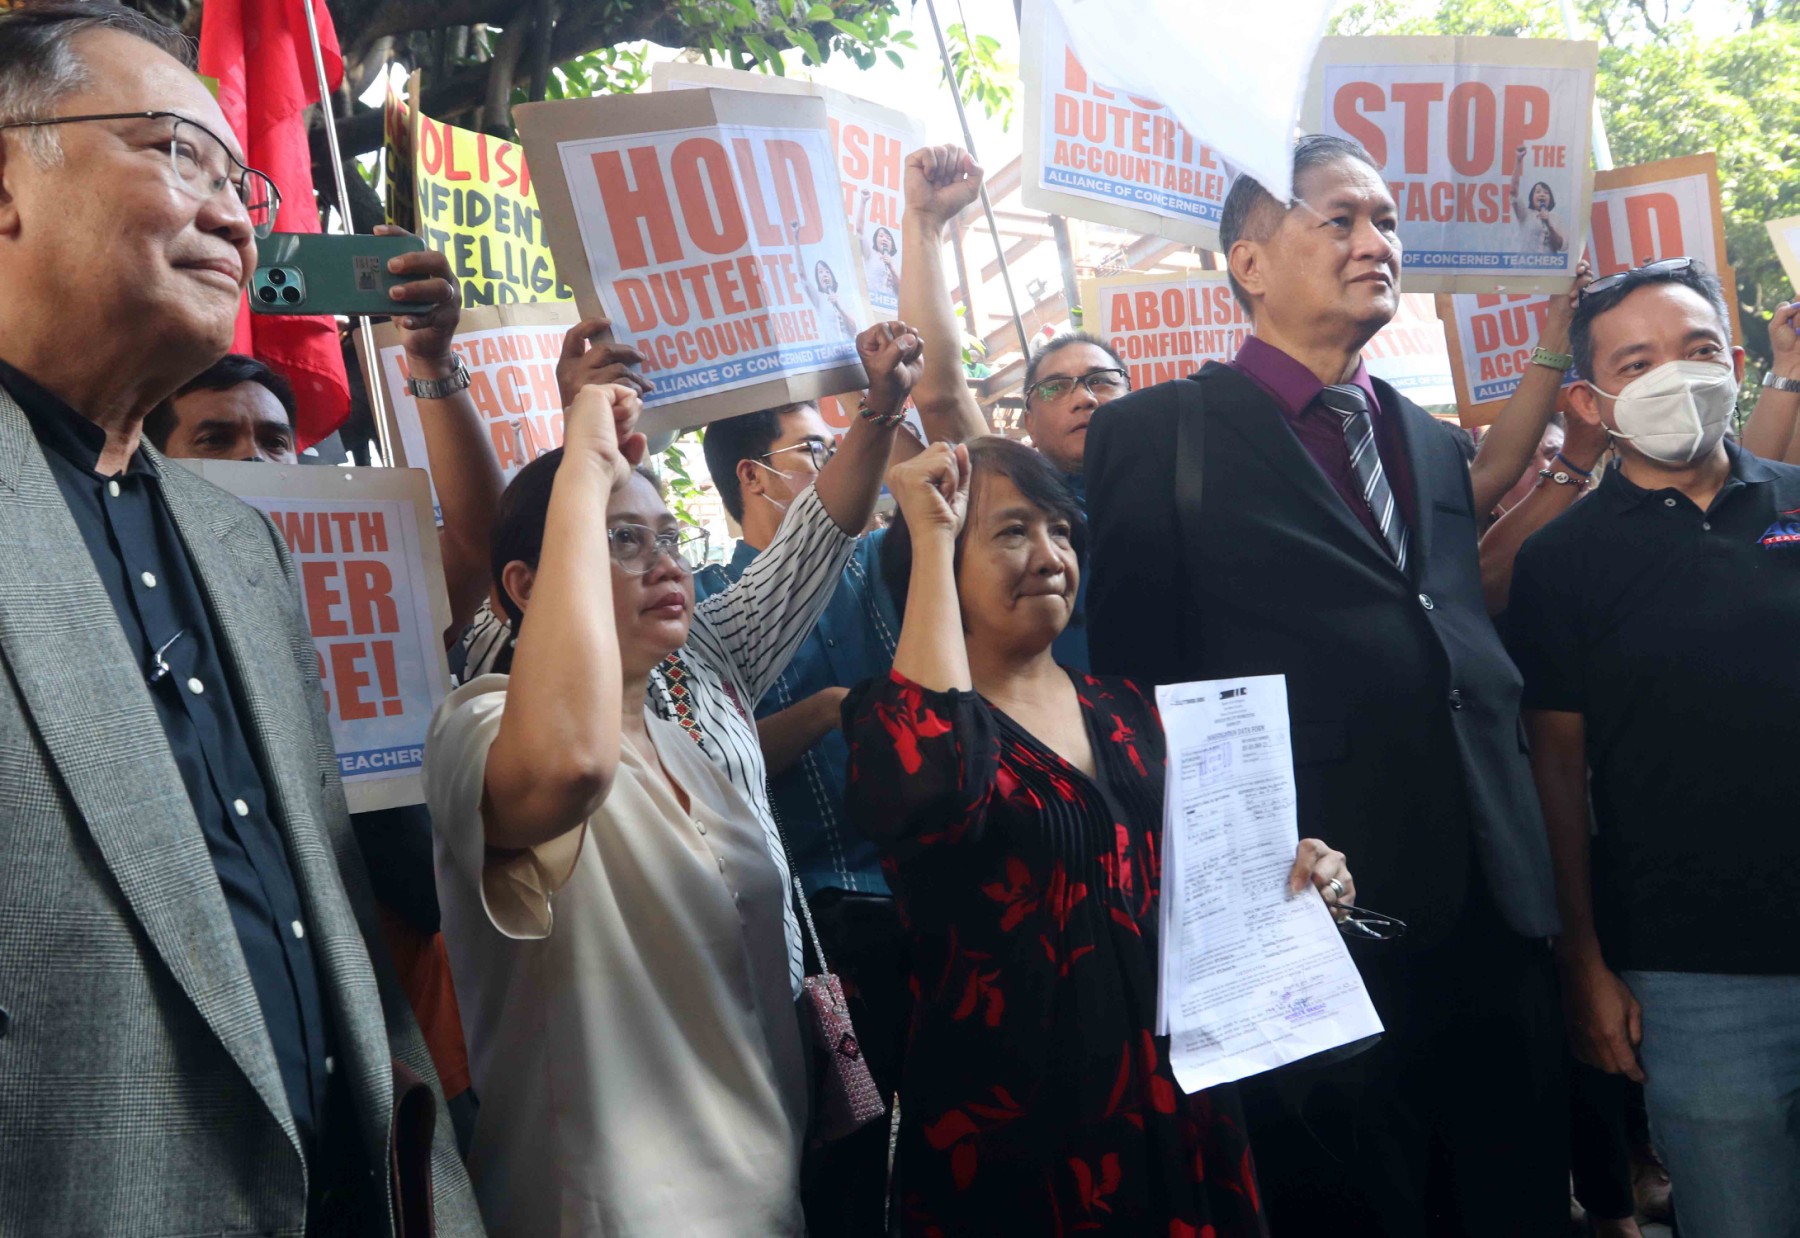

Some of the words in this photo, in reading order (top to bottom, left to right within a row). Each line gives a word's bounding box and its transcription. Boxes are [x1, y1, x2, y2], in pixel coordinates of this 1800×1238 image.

[417, 115, 530, 197] OLIS
[1333, 82, 1550, 177] STOP
[1531, 145, 1566, 168] THE
[1048, 170, 1111, 194] ALLIANCE
[1114, 184, 1131, 197] OF
[1135, 188, 1208, 216] CONCERNED
[1053, 139, 1224, 202] ACCOUNTABLE!
[590, 137, 824, 270] HOLD
[1403, 253, 1420, 263] OF
[1424, 254, 1499, 265] CONCERNED
[1503, 255, 1564, 266] TEACHERS
[1584, 192, 1684, 277] LD
[613, 253, 803, 333] DUTERTE
[637, 309, 818, 374] ACCOUNTABLE!
[722, 363, 744, 379] OF
[749, 351, 814, 373] CONCERNED
[1480, 350, 1534, 381] ACC
[270, 511, 389, 553] WITH
[337, 748, 425, 771] EACHER
